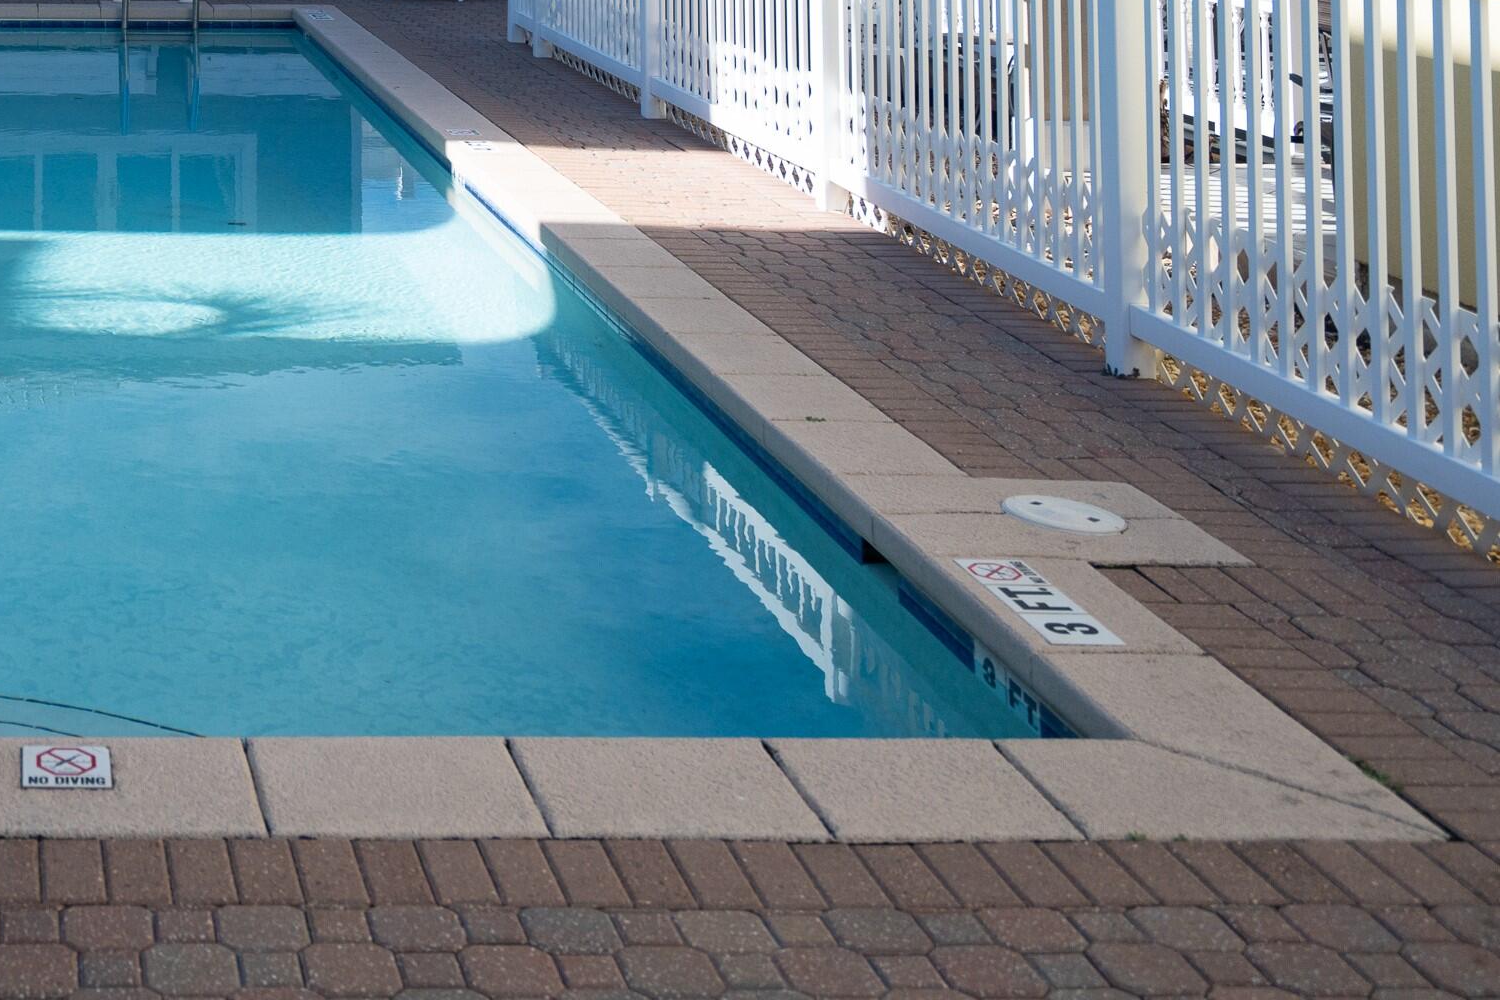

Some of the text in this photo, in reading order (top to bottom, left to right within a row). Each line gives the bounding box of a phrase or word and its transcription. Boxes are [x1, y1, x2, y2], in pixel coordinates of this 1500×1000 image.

[998, 586, 1099, 636] 3 FT.
[28, 776, 106, 785] NO DIVING
